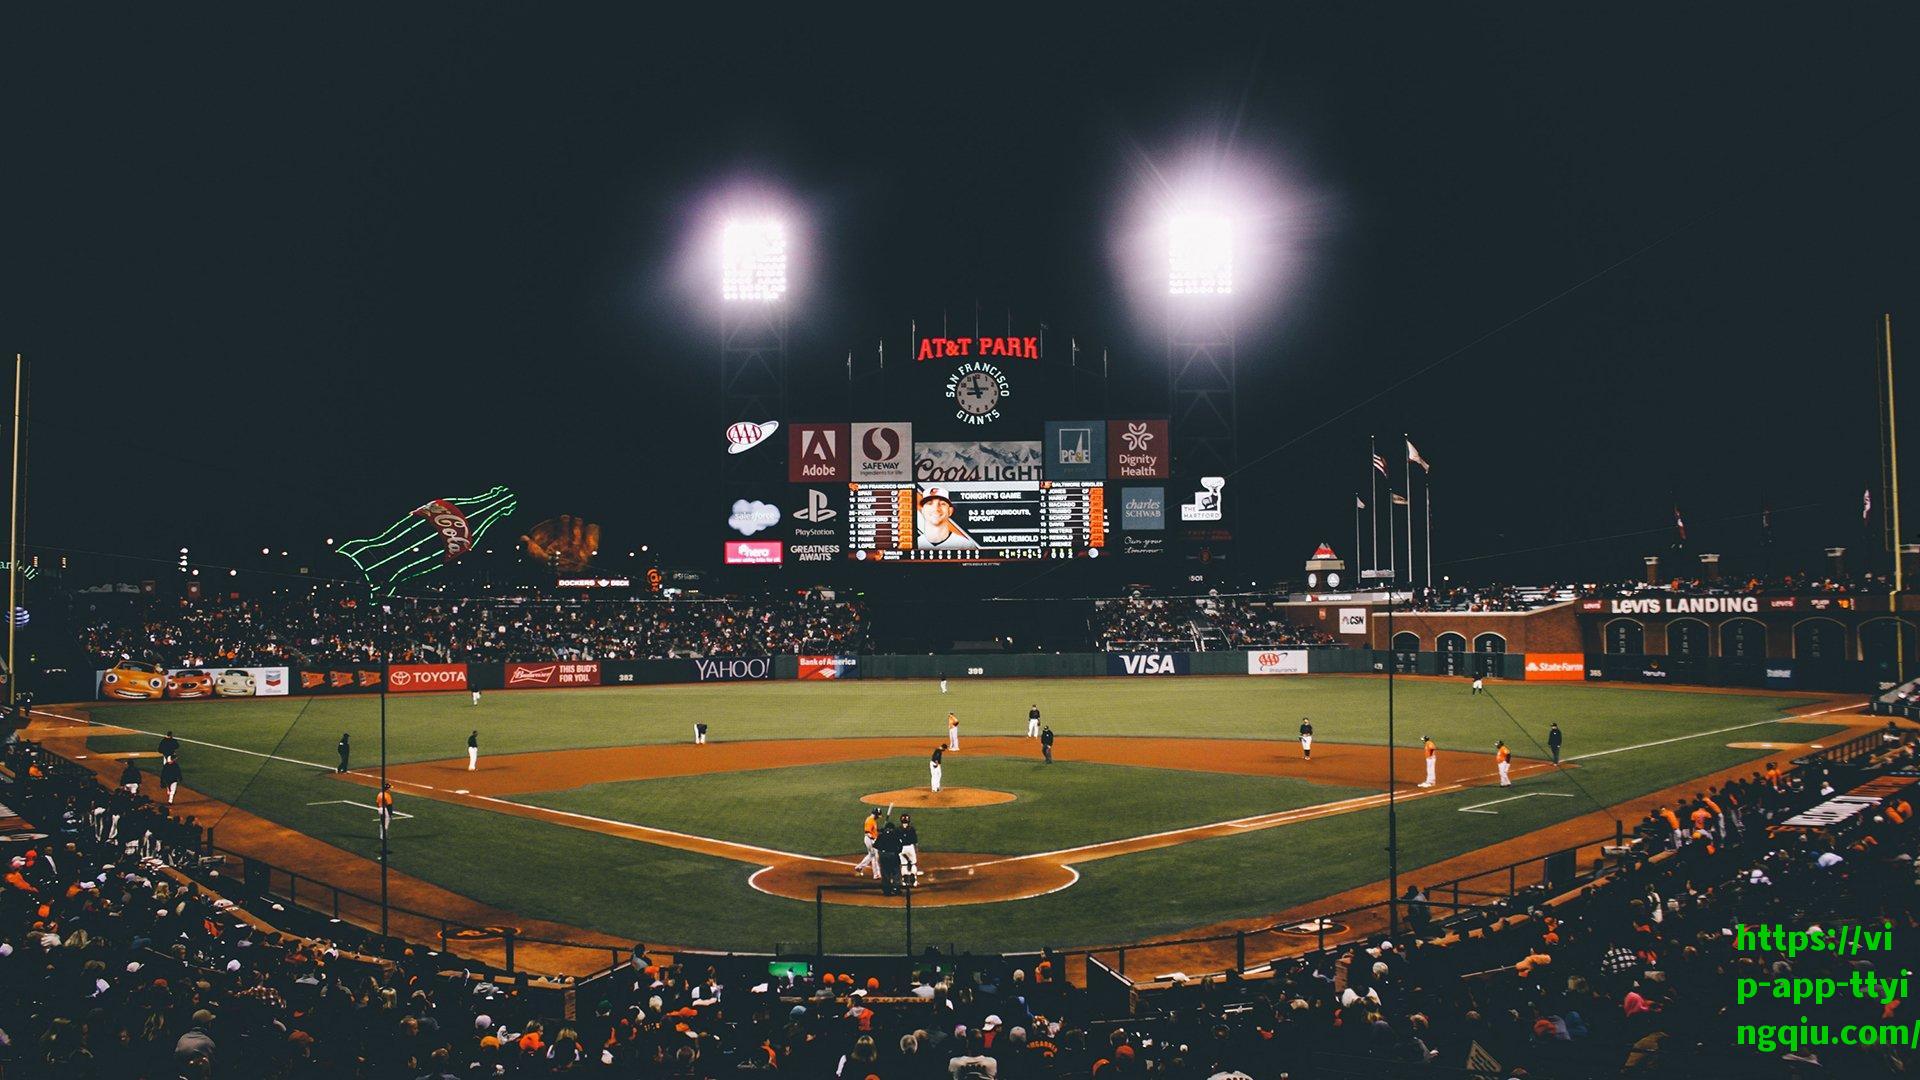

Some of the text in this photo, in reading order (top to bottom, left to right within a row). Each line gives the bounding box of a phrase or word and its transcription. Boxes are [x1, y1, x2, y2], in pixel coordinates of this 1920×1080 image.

[917, 336, 1038, 360] AT&T PARK
[946, 362, 1010, 398] SAN FRANCISCO
[956, 408, 1000, 425] GIANTS
[728, 424, 762, 444] AAA
[1060, 450, 1090, 463] PG&E
[1119, 454, 1156, 466] Dignity
[802, 464, 836, 476] Adobe
[862, 462, 900, 470] SAFEWAY
[915, 458, 1042, 480] Coors LIGHT
[1121, 466, 1156, 476] Health
[1126, 498, 1160, 510] charles
[1126, 510, 1161, 518] SCHWAB
[796, 529, 834, 537] PlayStation
[790, 545, 840, 554] GREATNESS
[1666, 597, 1759, 613] LANDING
[1350, 616, 1364, 625] CSN
[1119, 654, 1175, 674] VISA
[1259, 653, 1279, 666] AAA
[560, 664, 598, 673] THIS BUD'S
[696, 658, 770, 680] YAHOO!
[413, 672, 466, 683] TOYOTA
[560, 674, 590, 682] FOR YOU.
